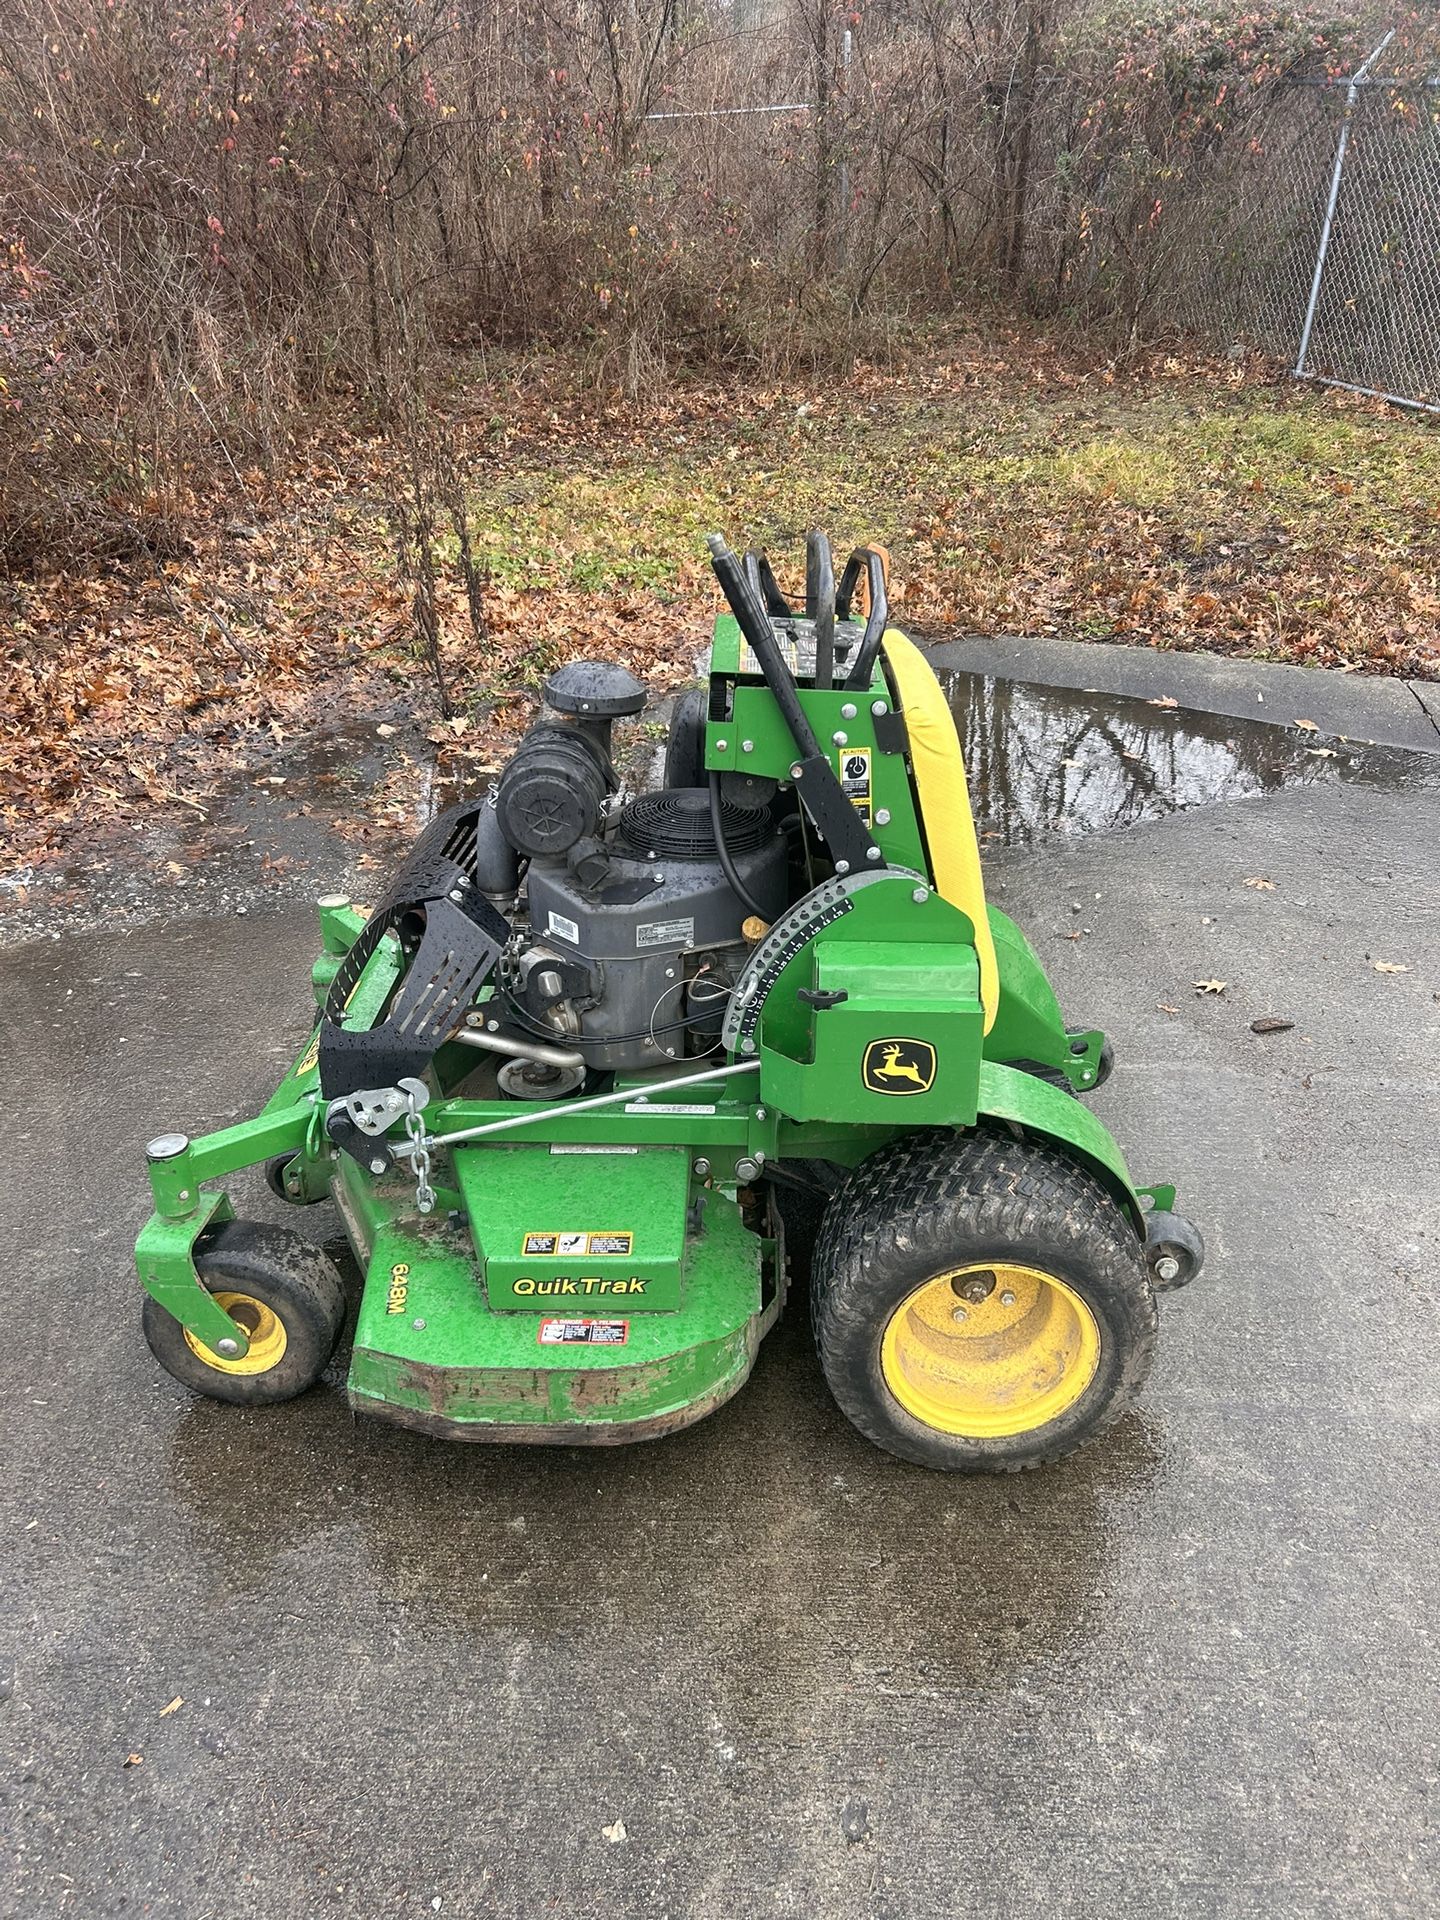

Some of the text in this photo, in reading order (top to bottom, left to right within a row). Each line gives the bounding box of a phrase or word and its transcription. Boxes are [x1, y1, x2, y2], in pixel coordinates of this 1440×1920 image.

[766, 979, 775, 989] 2.75
[833, 910, 843, 919] 4.75
[387, 1263, 410, 1315] 648M
[512, 1277, 649, 1295] QuikTrak
